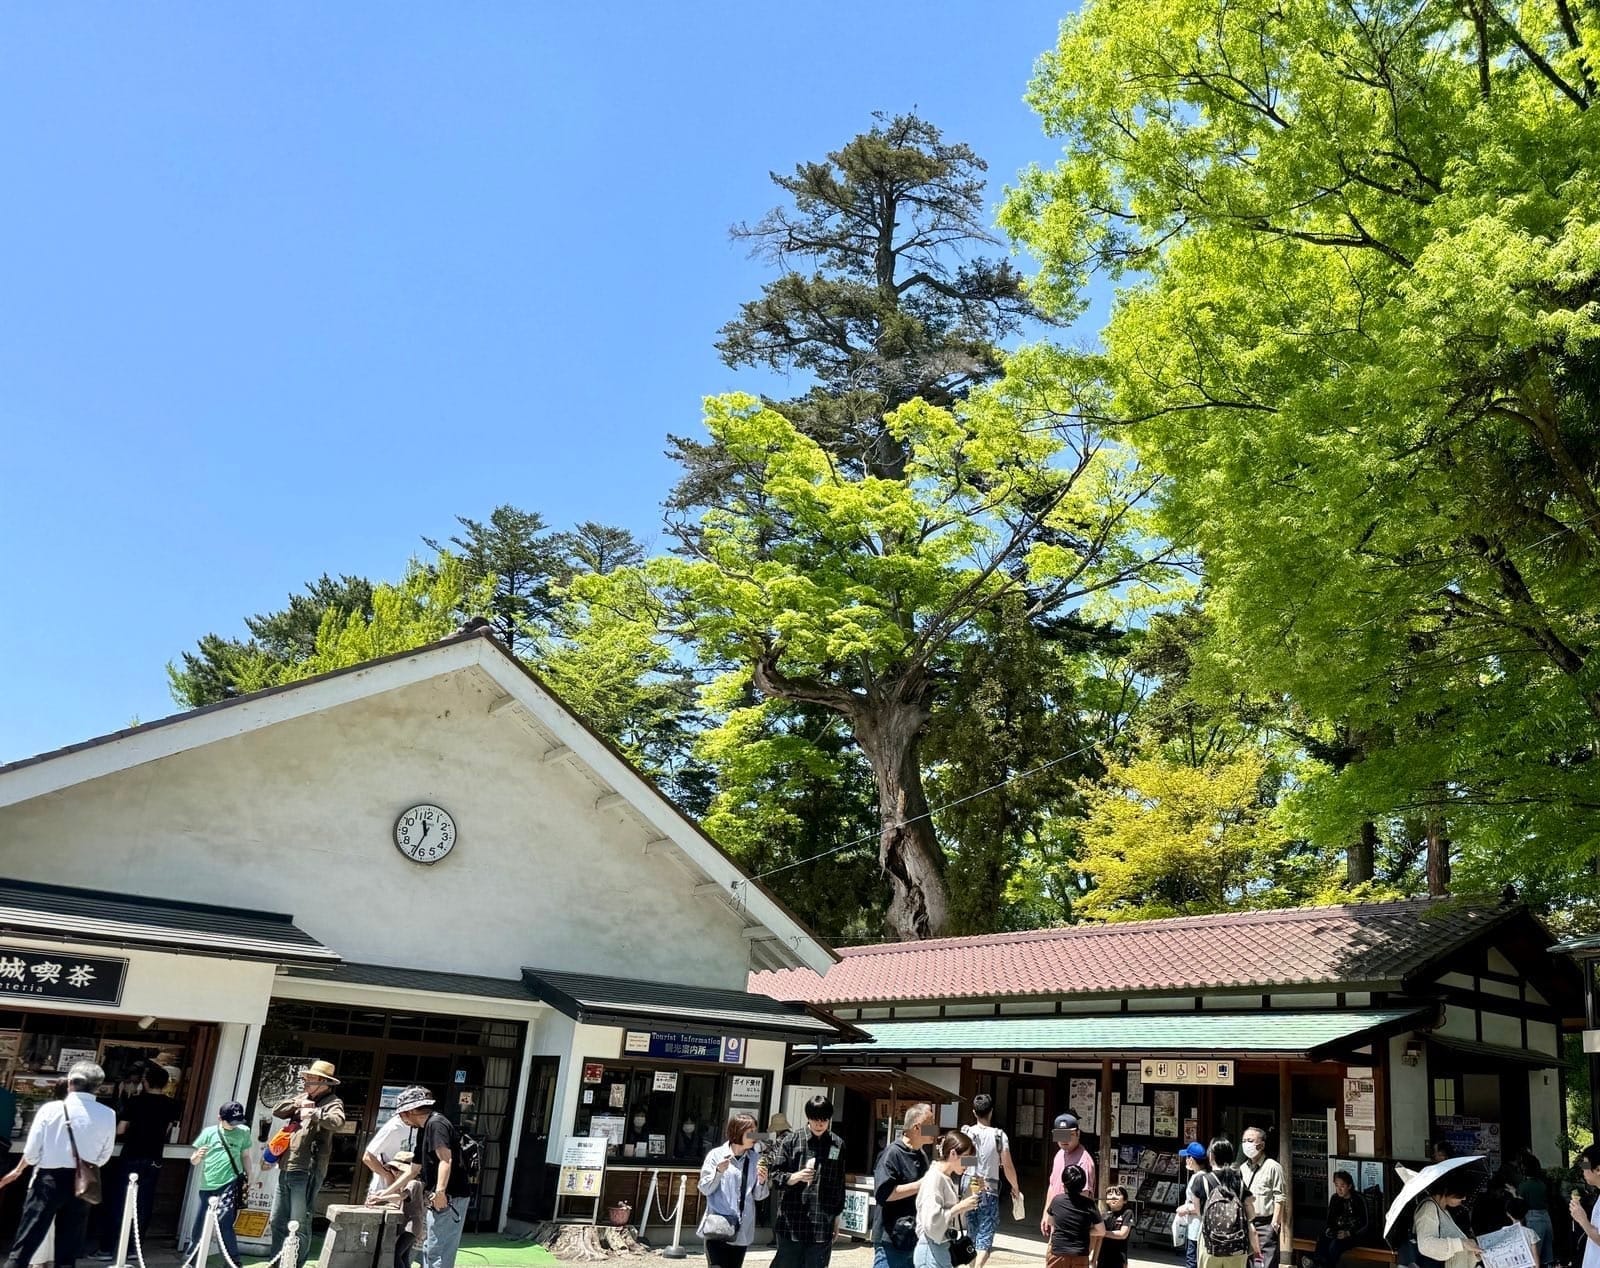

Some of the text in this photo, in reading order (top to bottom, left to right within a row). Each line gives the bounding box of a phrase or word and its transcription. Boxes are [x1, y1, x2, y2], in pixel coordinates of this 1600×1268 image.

[424, 811, 433, 820] 12
[405, 818, 414, 826] 10
[402, 827, 408, 835] 9
[441, 823, 447, 831] 2
[403, 836, 410, 844] 8
[442, 833, 448, 841] 3
[418, 848, 425, 856] 6
[429, 847, 436, 856] 5
[651, 1031, 721, 1045] Tourist Information
